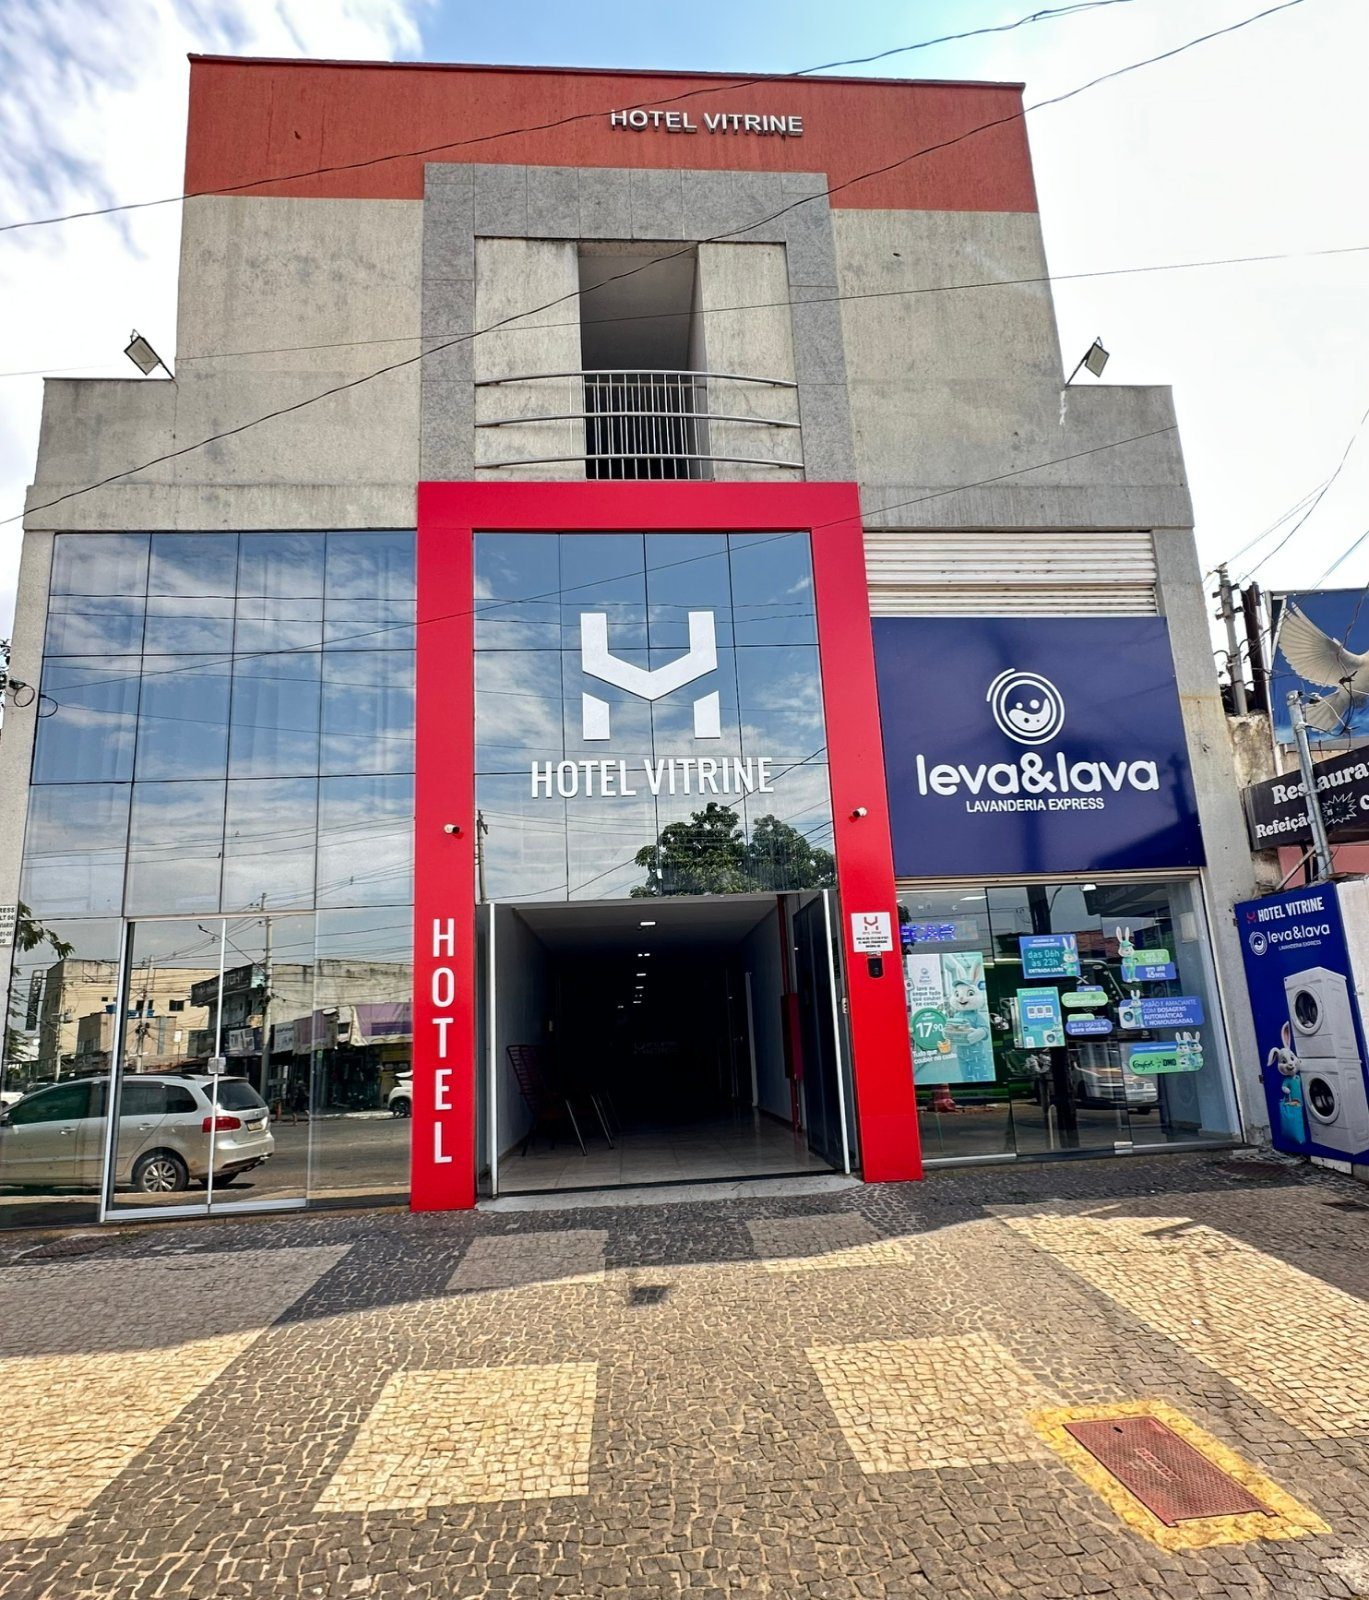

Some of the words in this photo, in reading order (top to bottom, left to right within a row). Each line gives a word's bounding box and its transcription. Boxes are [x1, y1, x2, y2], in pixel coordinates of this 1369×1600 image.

[611, 110, 698, 132] HOTEL
[704, 113, 804, 135] VITRINE
[531, 759, 637, 798] HOTEL
[643, 757, 775, 796] VITRINE
[916, 751, 1160, 796] leva&lava
[966, 799, 1047, 812] LAVANDERIA
[1048, 797, 1105, 810] EXPRESS
[1255, 812, 1311, 838] Refeiçã
[1257, 905, 1286, 922] HOTEL
[1286, 896, 1325, 916] VITRINE
[1267, 923, 1331, 944] leva&lava
[1044, 958, 1058, 966] 23h
[1045, 949, 1059, 958] 06h
[431, 918, 455, 1164] HOTEL
